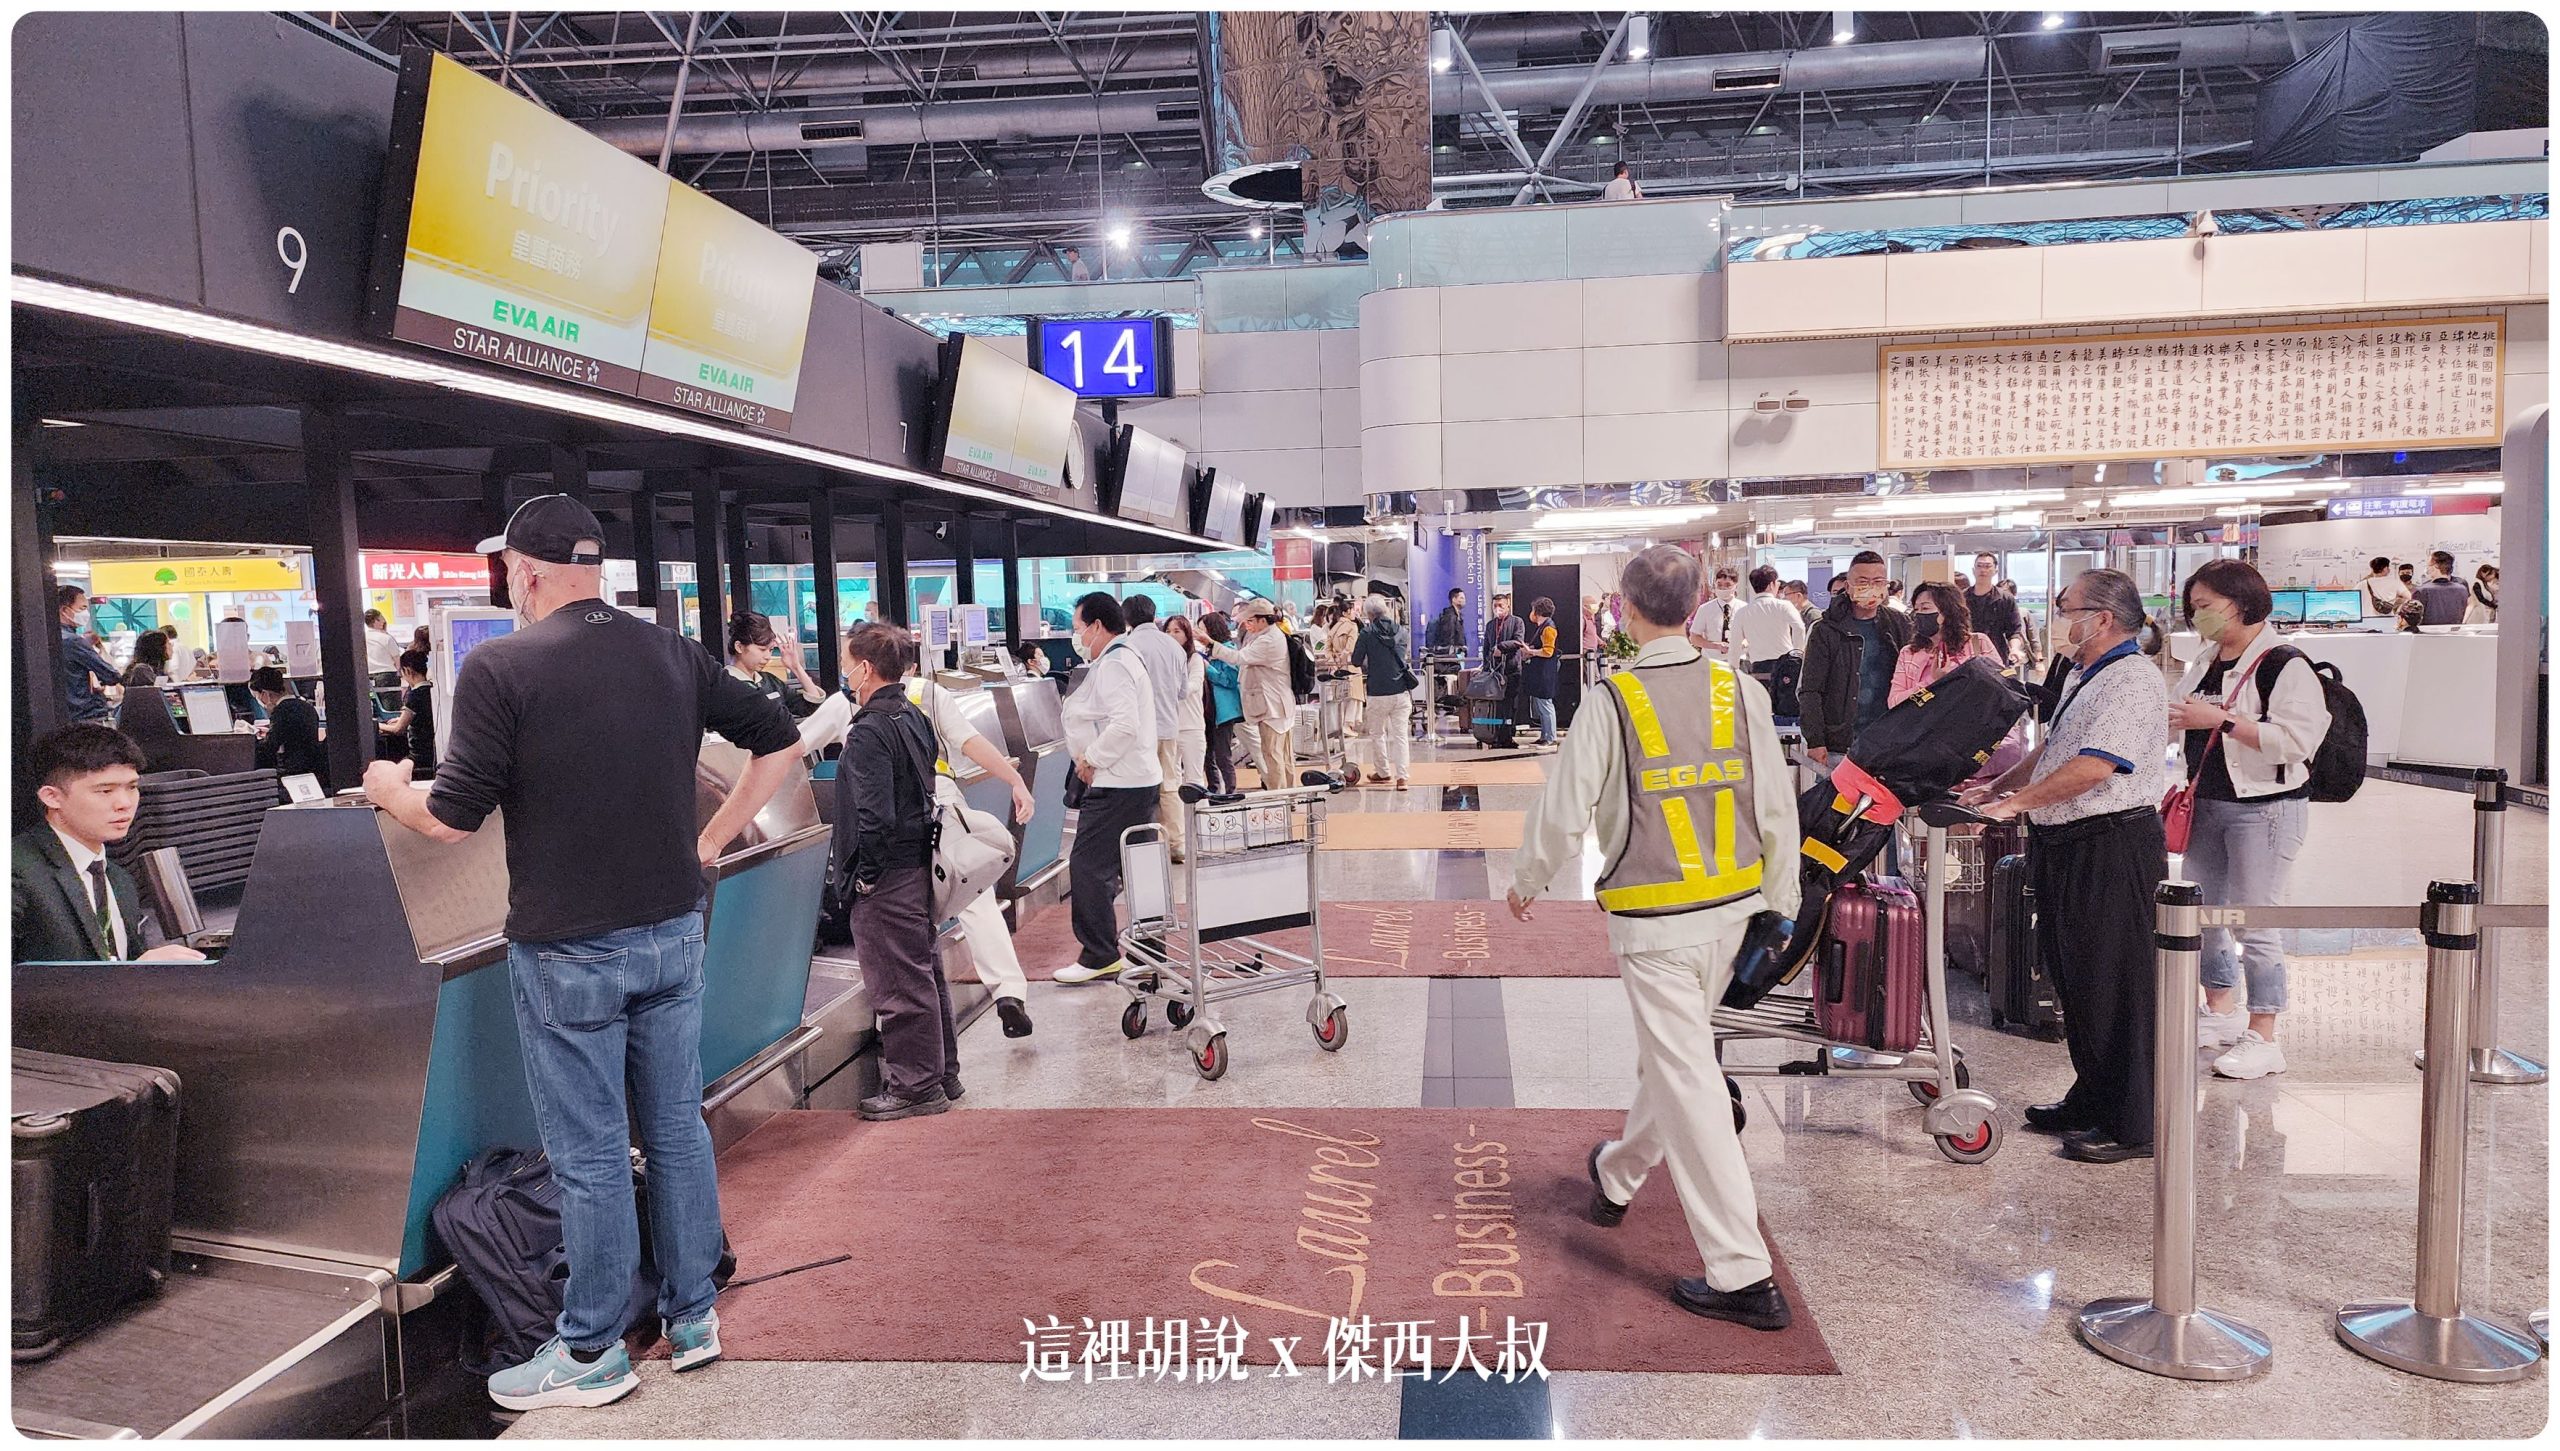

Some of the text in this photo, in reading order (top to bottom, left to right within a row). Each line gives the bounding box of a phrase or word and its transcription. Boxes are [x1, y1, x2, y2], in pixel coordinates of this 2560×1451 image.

[486, 141, 623, 258] Priority
[277, 226, 308, 294] 9
[453, 327, 584, 378] STAR ALLIANCE
[1060, 328, 1144, 389] 14
[673, 386, 756, 421] STAR ALLIANCE
[956, 462, 992, 482] STAR ALLIANCE
[371, 562, 439, 580] 新光人壽
[1467, 534, 1476, 584] check-in
[1641, 758, 1745, 792] EGAS
[1188, 1116, 1381, 1323] Laurel
